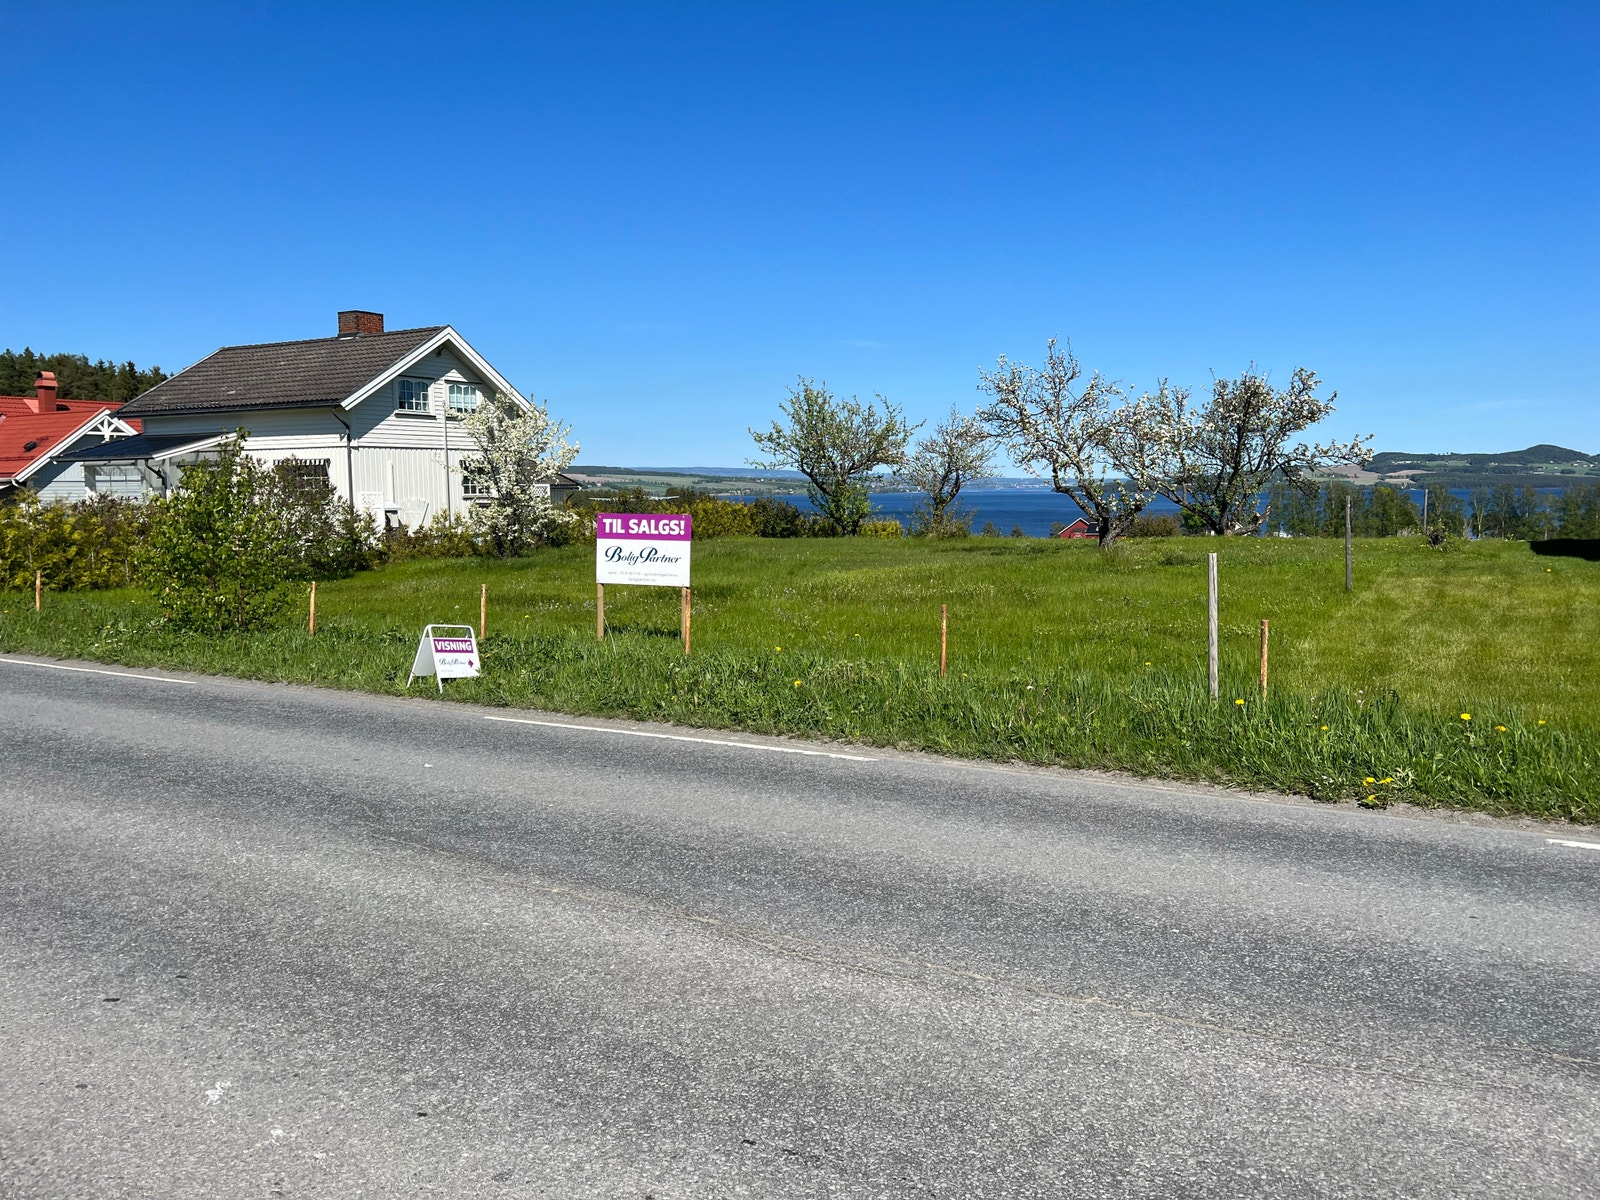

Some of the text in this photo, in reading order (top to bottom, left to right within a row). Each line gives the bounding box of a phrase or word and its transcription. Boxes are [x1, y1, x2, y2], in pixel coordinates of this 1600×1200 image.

[602, 518, 685, 536] TIL SALGS!
[435, 640, 472, 651] VISNING
